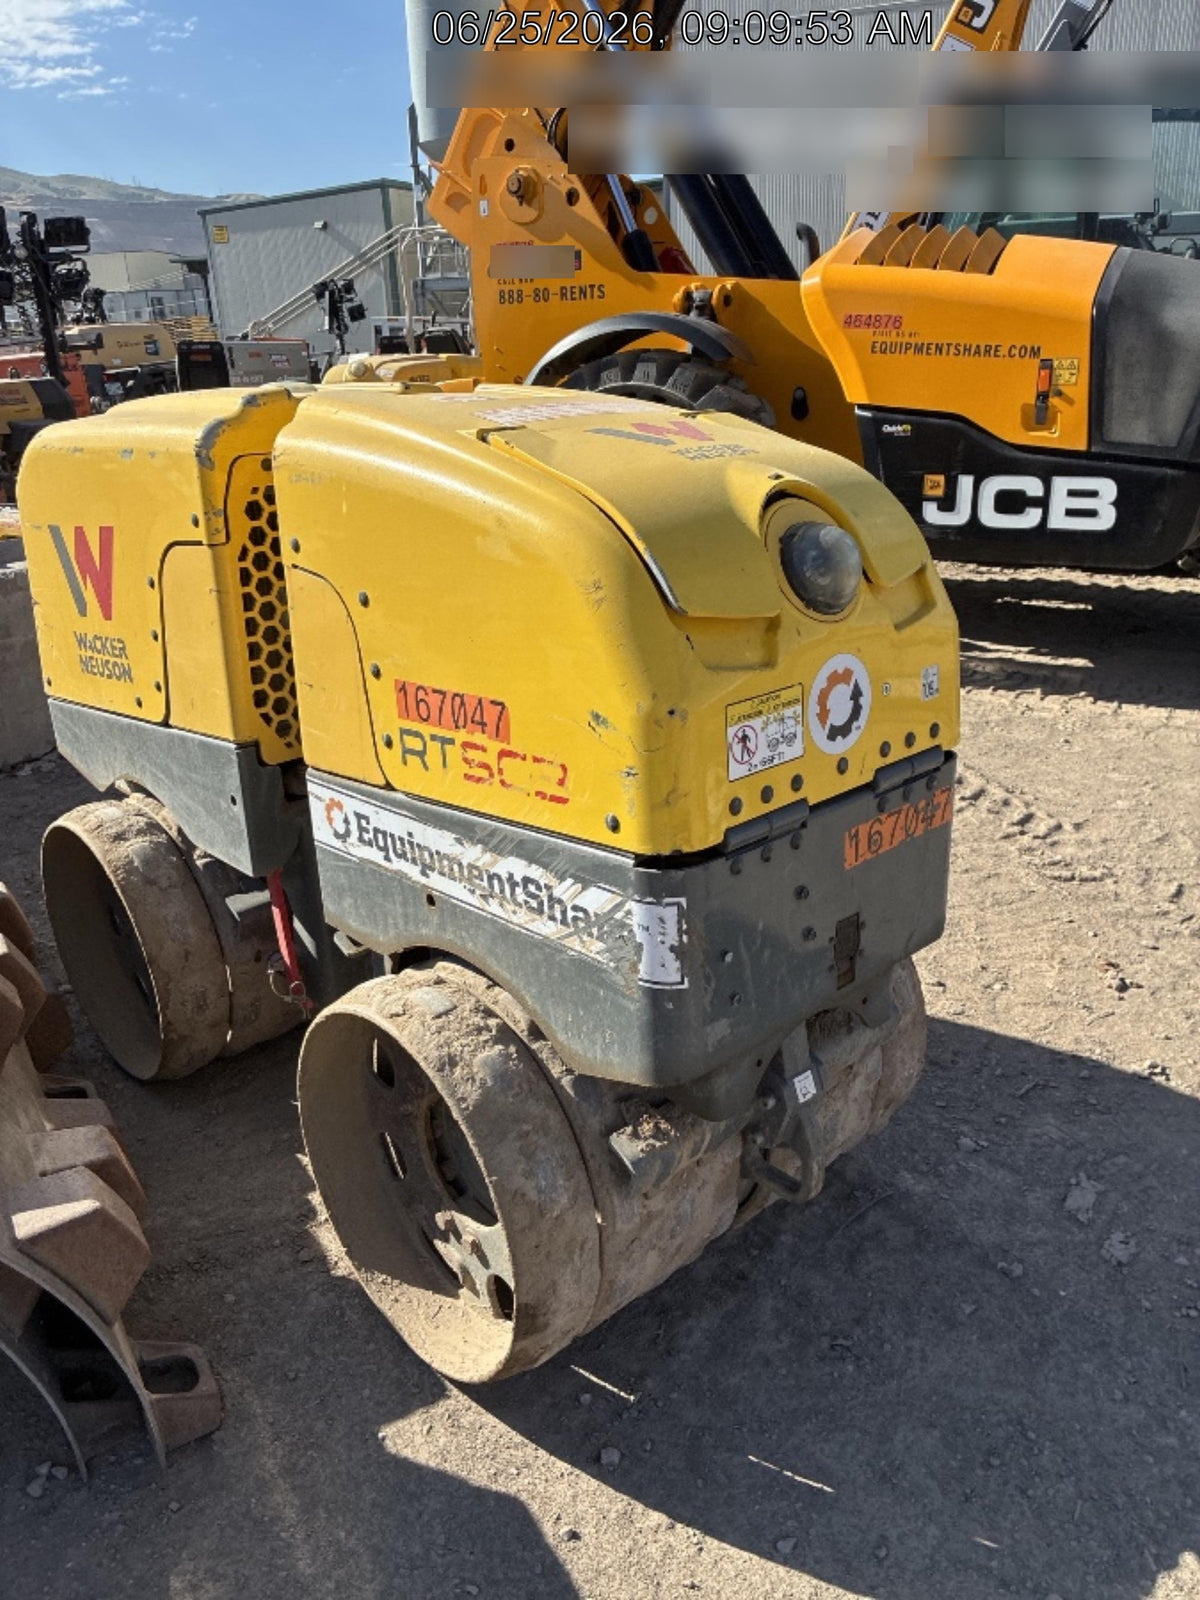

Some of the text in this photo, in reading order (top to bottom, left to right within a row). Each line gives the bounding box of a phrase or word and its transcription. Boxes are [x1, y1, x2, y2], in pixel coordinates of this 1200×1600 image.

[498, 284, 606, 305] 888-80-RENTS
[843, 314, 903, 329] 464876
[870, 341, 1042, 359] EQUIPMENTSHARE.COM
[922, 474, 1118, 531] JCB
[79, 654, 133, 684] NEUSON
[397, 680, 506, 739] 167047
[847, 786, 952, 863] 167047
